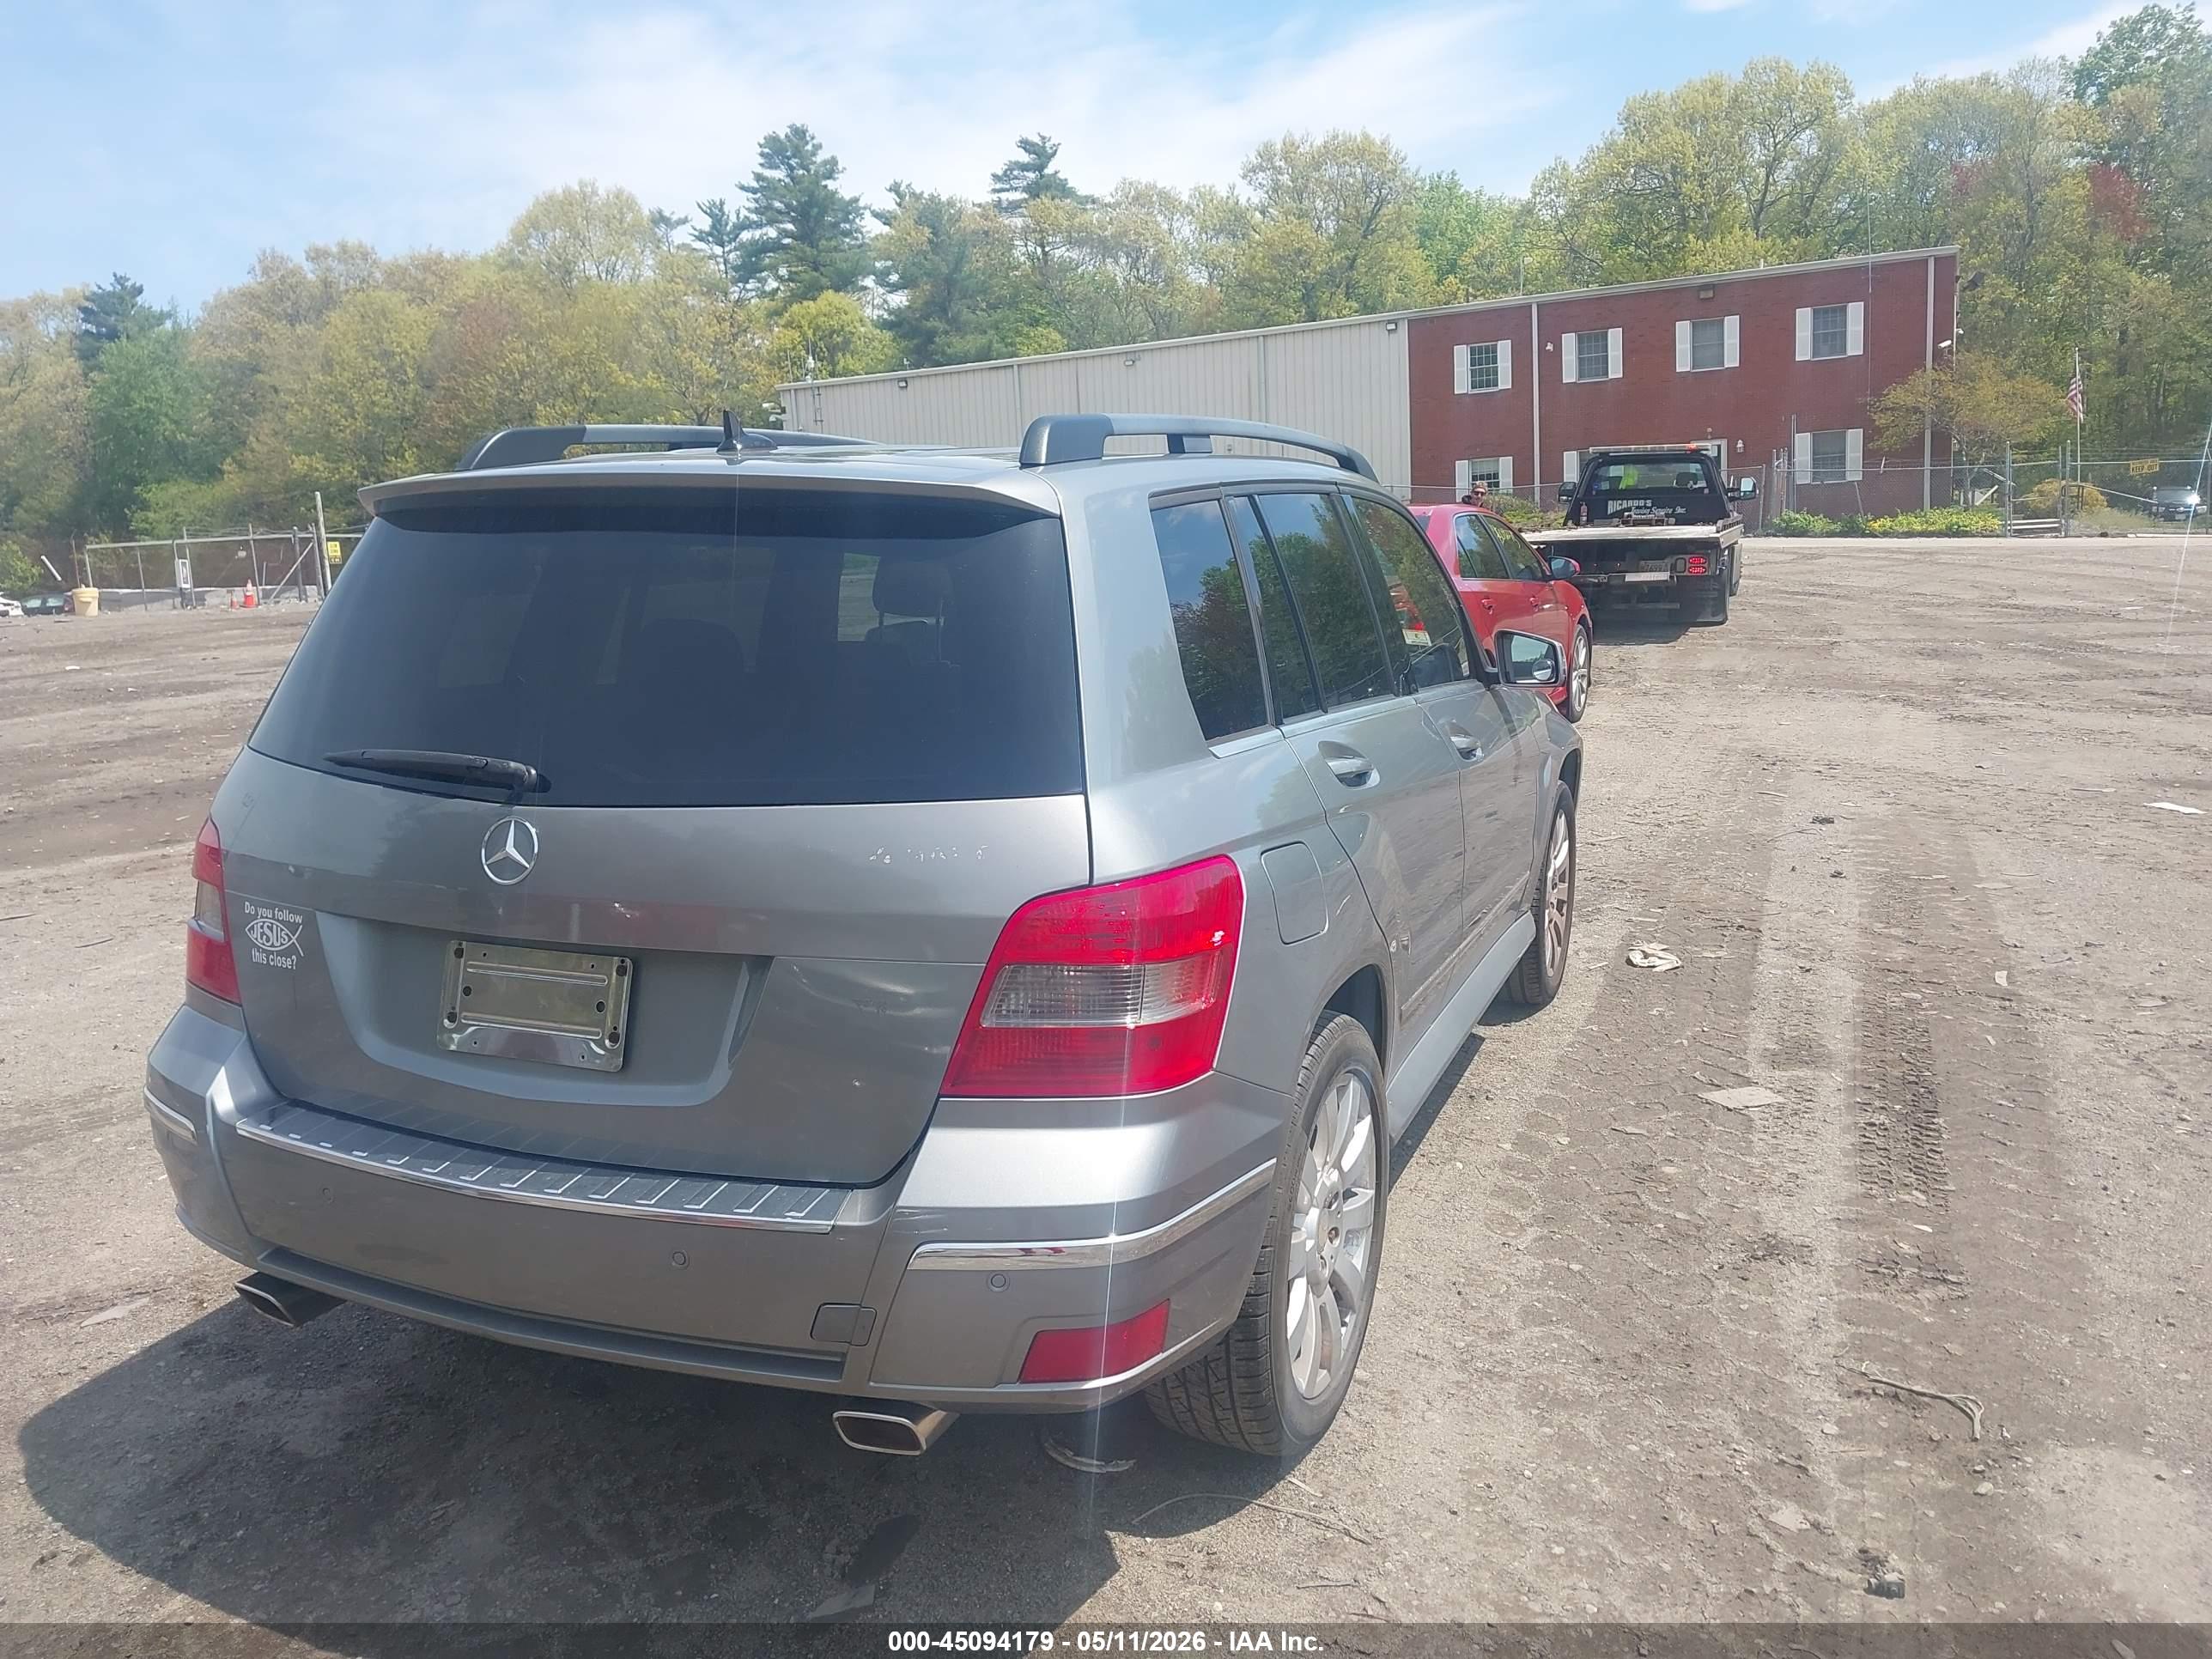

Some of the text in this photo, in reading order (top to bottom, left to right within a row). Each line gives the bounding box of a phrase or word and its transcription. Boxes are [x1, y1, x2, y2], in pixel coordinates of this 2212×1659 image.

[245, 902, 302, 923] Do you follow
[251, 922, 289, 946] JESUS
[252, 947, 296, 969] this close?
